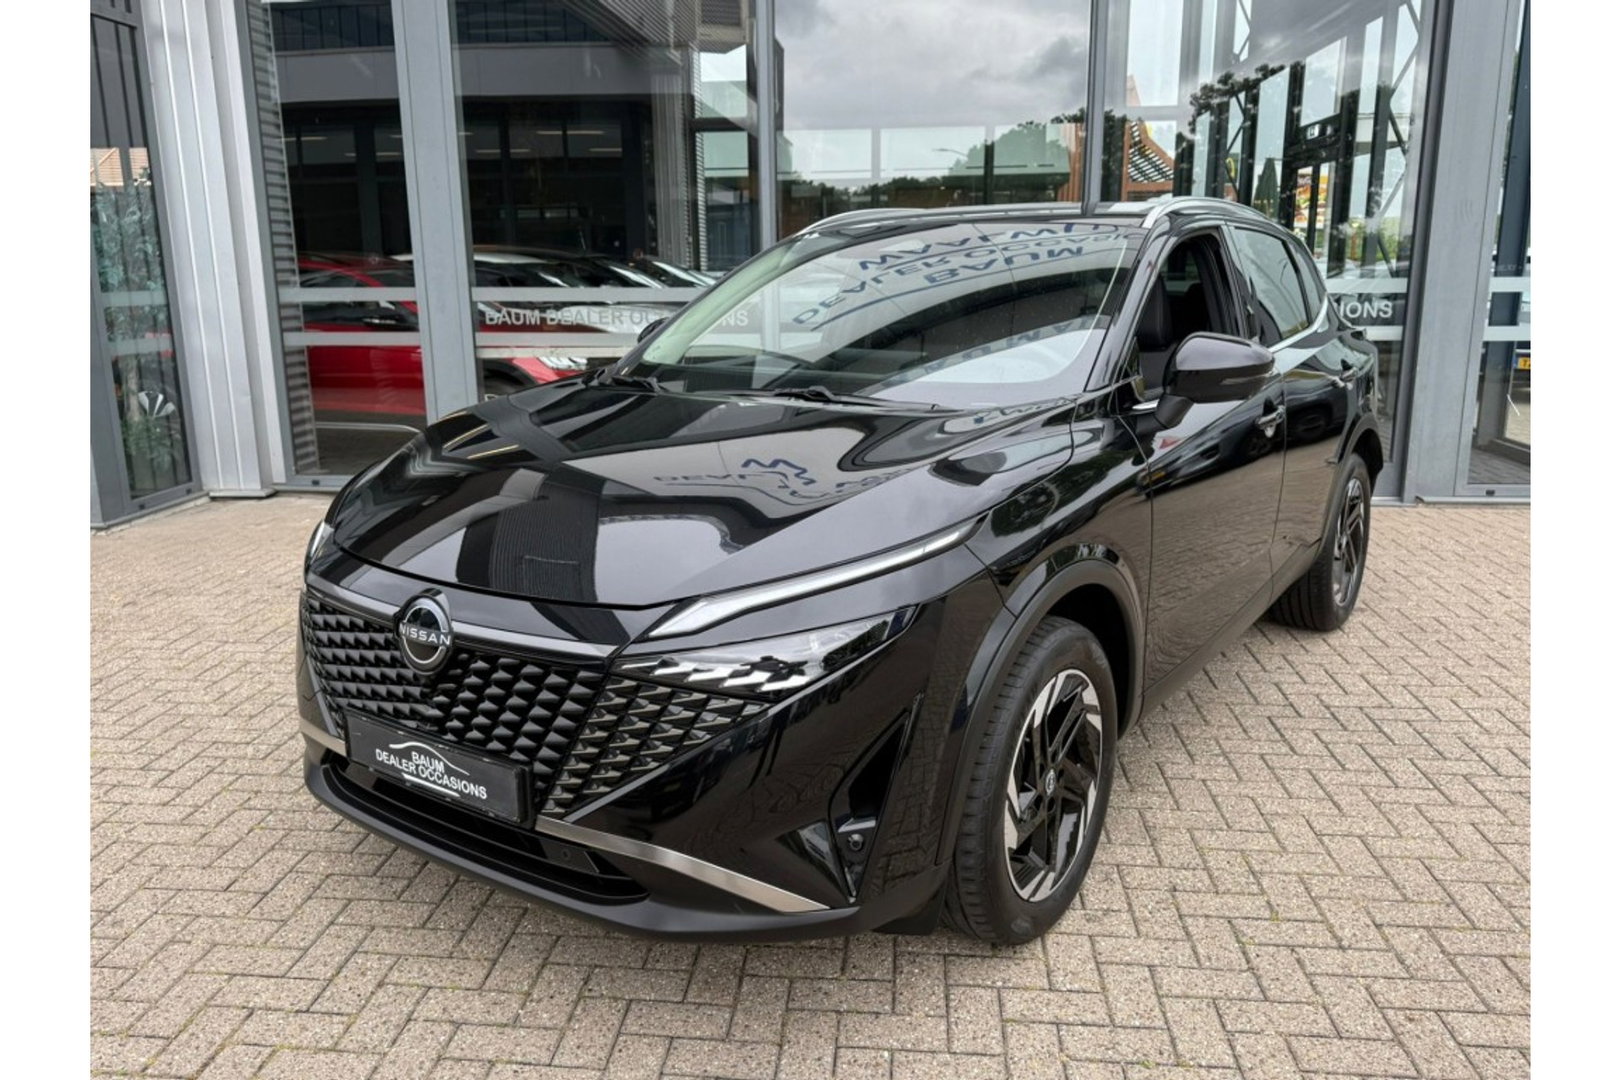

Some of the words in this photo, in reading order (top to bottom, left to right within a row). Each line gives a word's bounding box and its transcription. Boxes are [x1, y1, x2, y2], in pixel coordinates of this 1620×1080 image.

[485, 310, 540, 325] BAUM
[547, 310, 625, 325] DEALER
[399, 622, 451, 645] NISSAN
[411, 751, 445, 773] BAUM
[375, 749, 417, 775] DEALER
[418, 765, 487, 799] OCCASIONS
